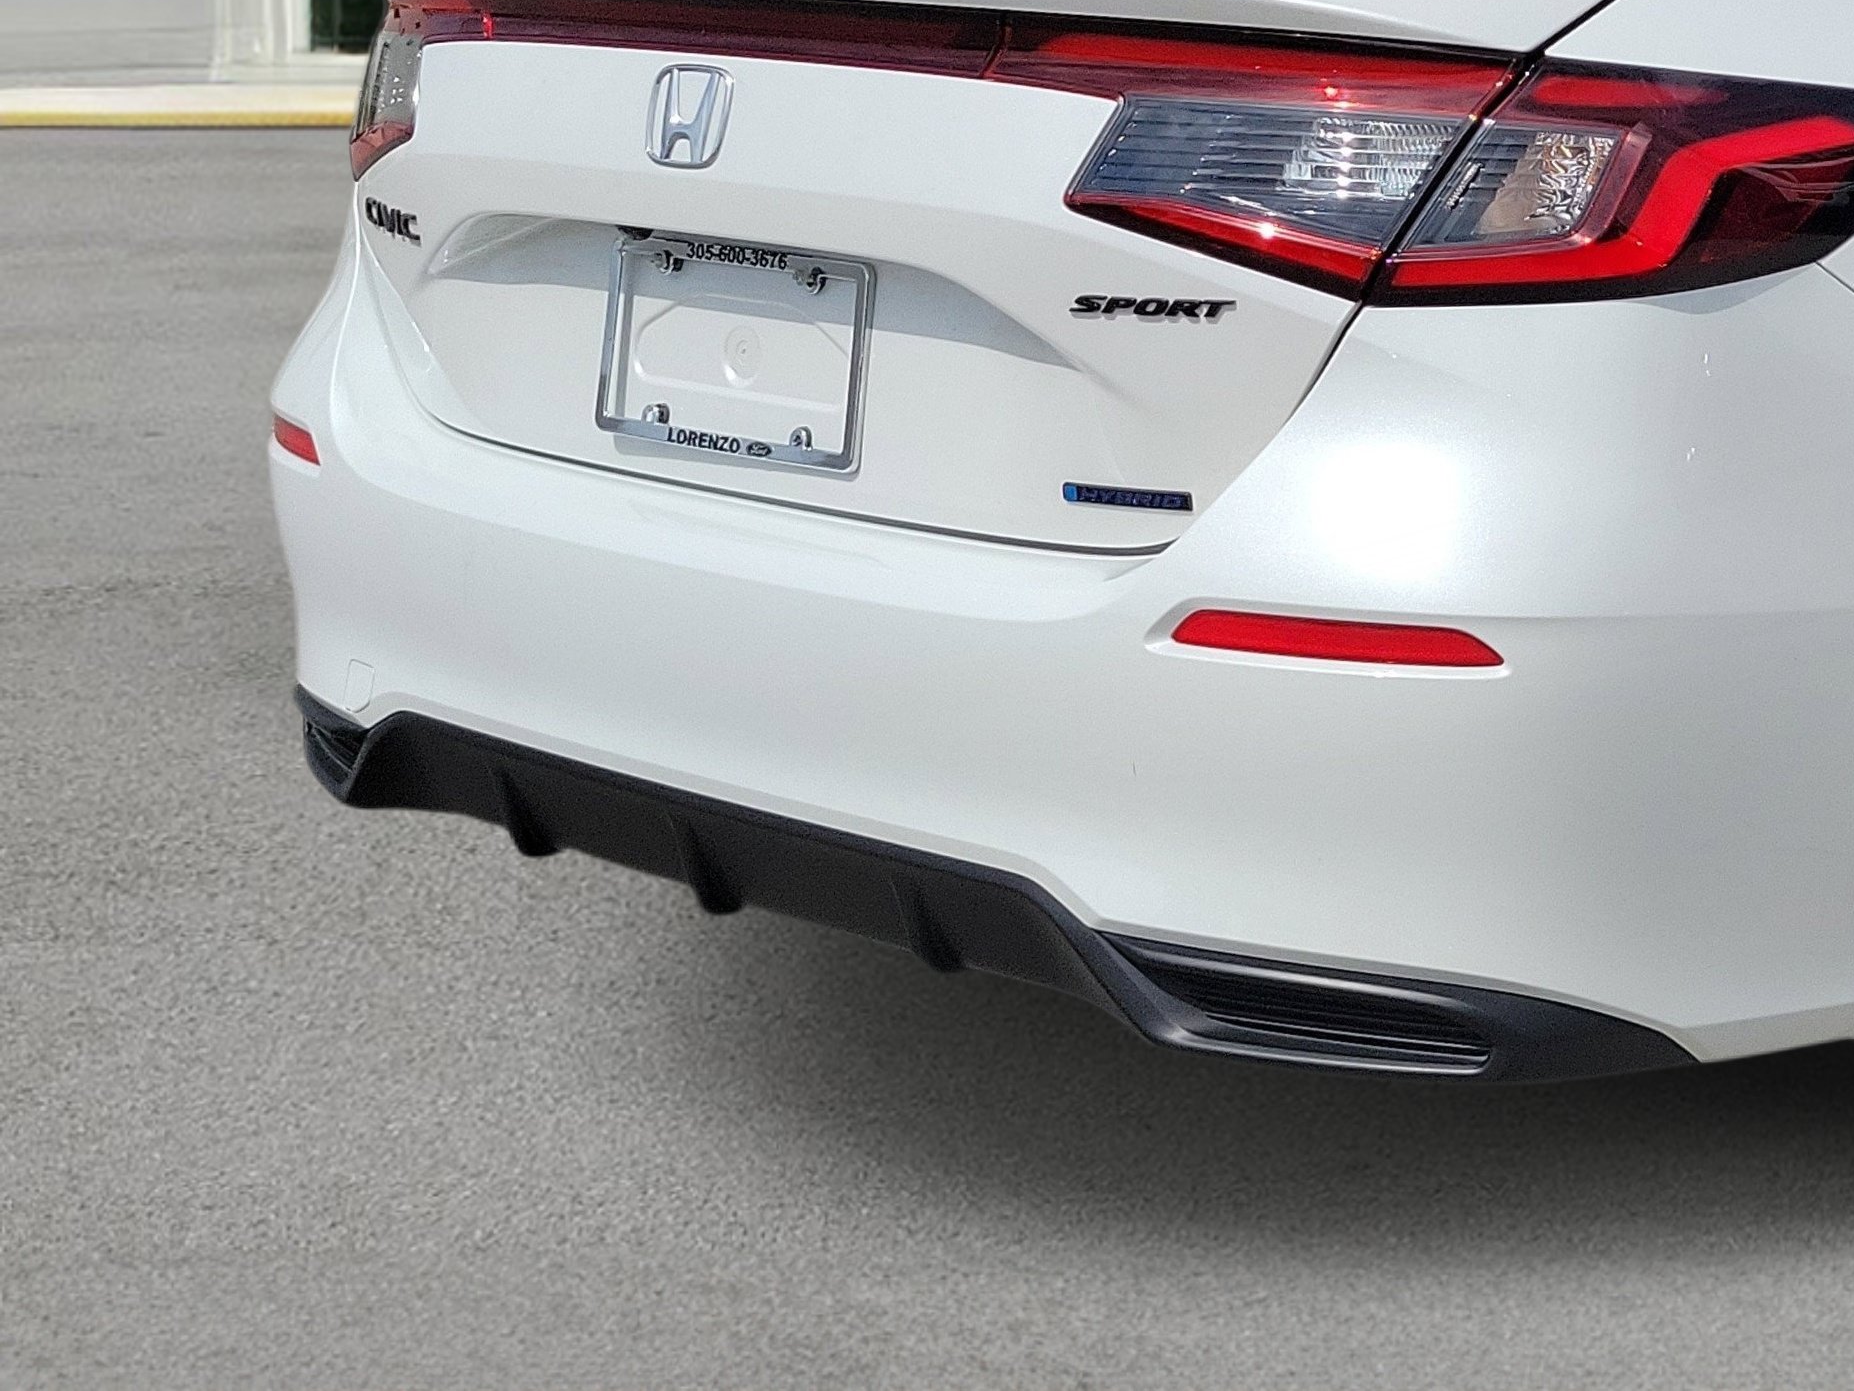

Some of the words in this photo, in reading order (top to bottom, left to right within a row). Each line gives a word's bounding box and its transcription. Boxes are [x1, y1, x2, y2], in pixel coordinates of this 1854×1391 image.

[365, 196, 421, 241] CIVIC
[1069, 294, 1237, 320] SPORT
[666, 426, 741, 454] LORENZO
[1079, 487, 1182, 508] HYBRID
